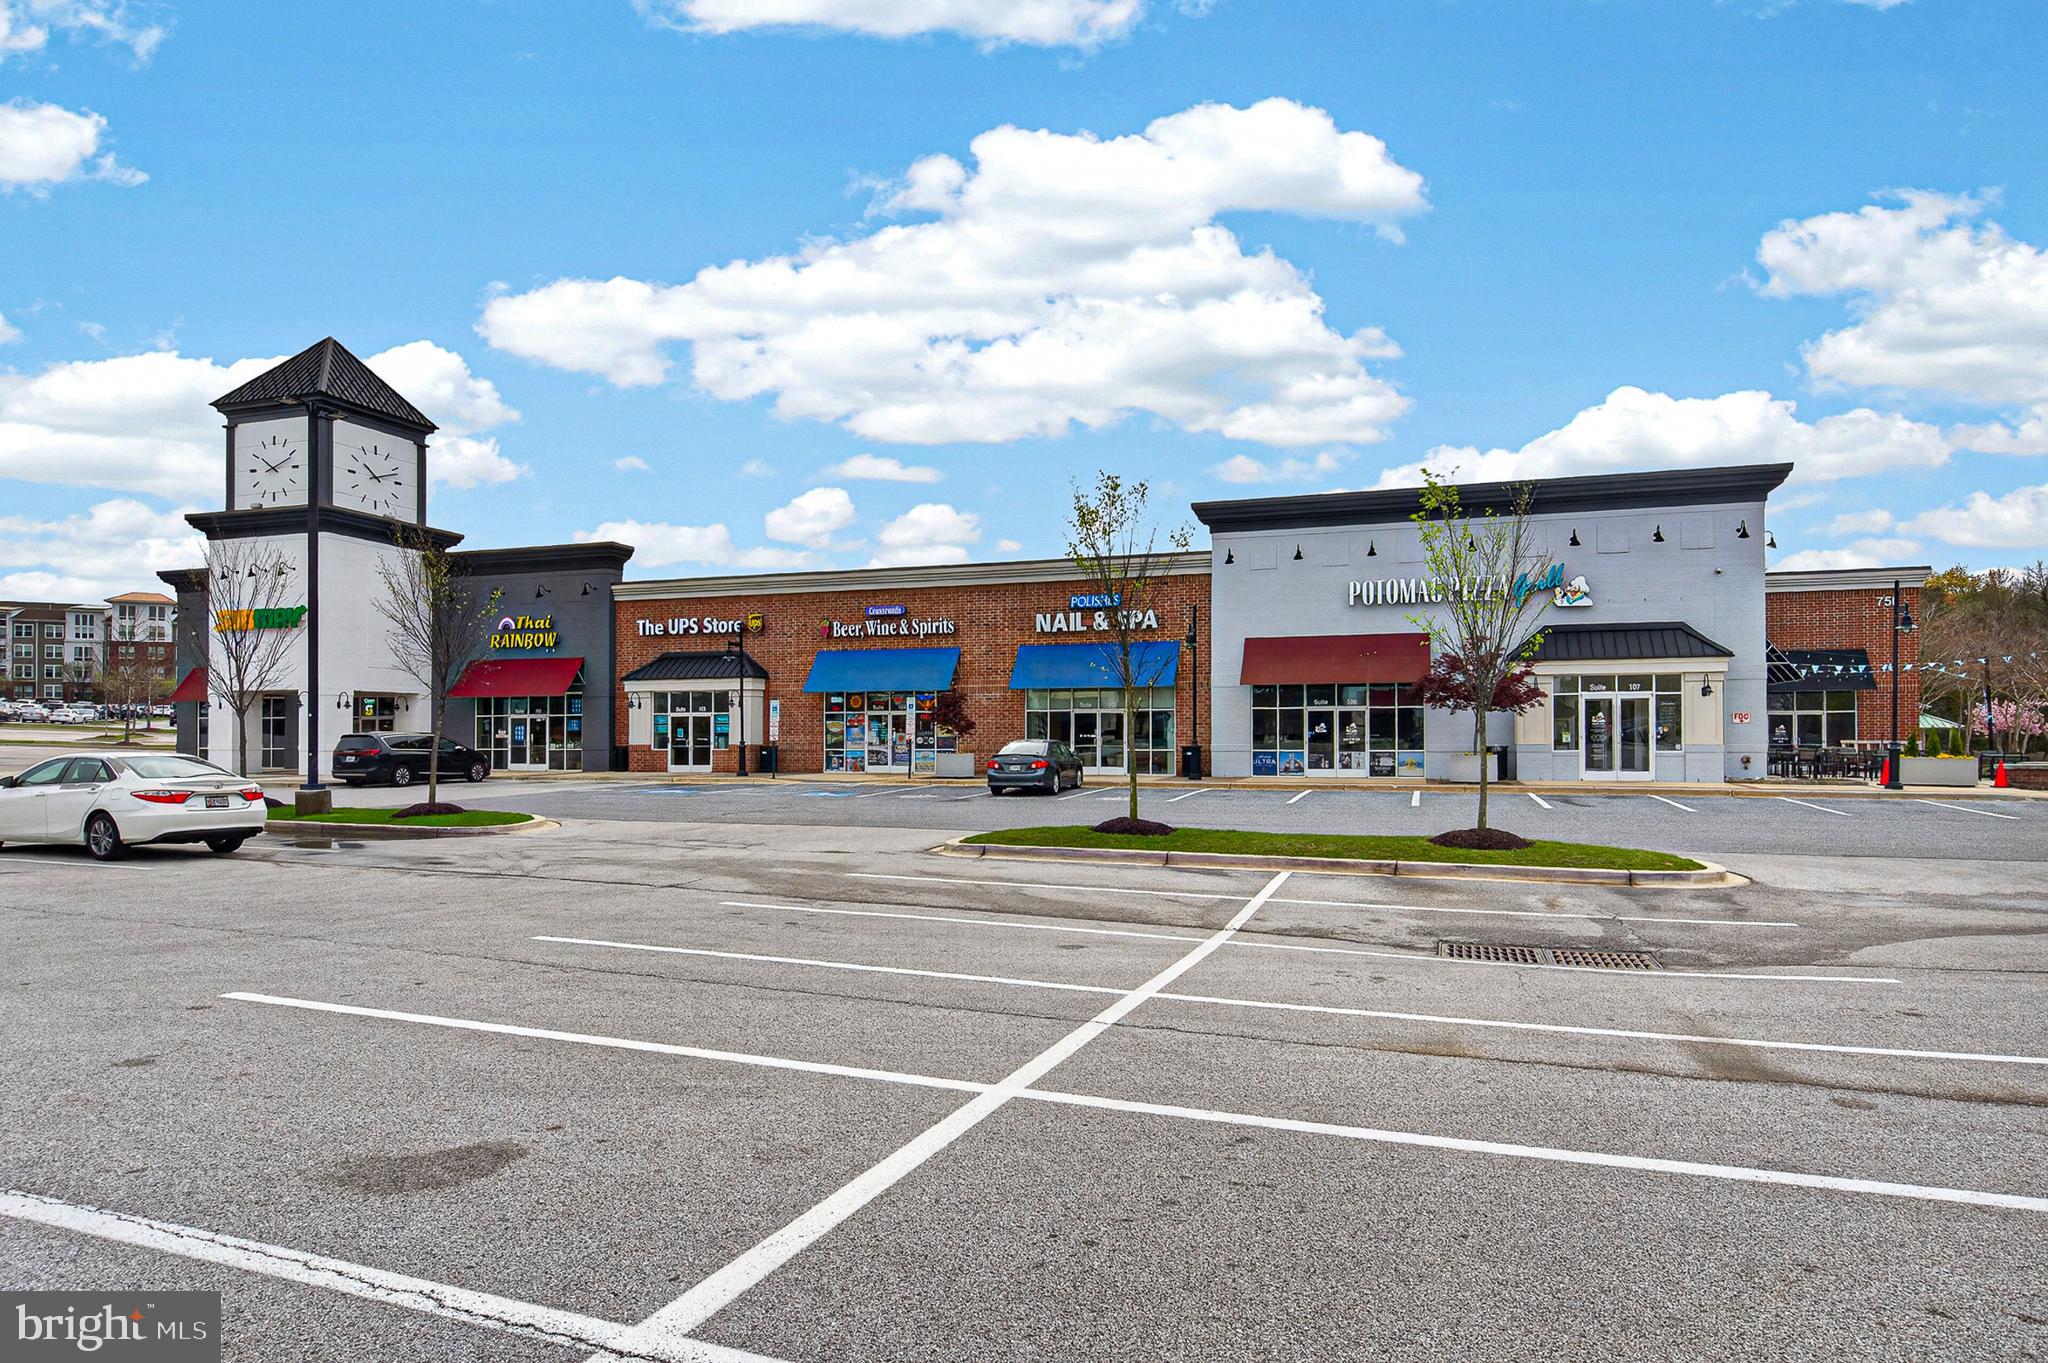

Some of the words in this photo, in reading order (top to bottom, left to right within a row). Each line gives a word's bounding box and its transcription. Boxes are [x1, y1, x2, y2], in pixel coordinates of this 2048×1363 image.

[1350, 577, 1442, 605] POTOMAC
[516, 614, 552, 629] Thai
[637, 619, 664, 636] The
[668, 618, 699, 634] UPS
[703, 618, 743, 633] Store
[833, 621, 864, 638] Beer,
[865, 619, 897, 635] Wine
[899, 618, 909, 634] &
[912, 616, 955, 638] Spirits
[1035, 612, 1087, 632] NAIL
[1093, 611, 1109, 631] &
[490, 632, 558, 649] RAINBOW
[1589, 683, 1607, 691] Suite
[1629, 683, 1641, 691] 107
[1733, 712, 1750, 720] FDC
